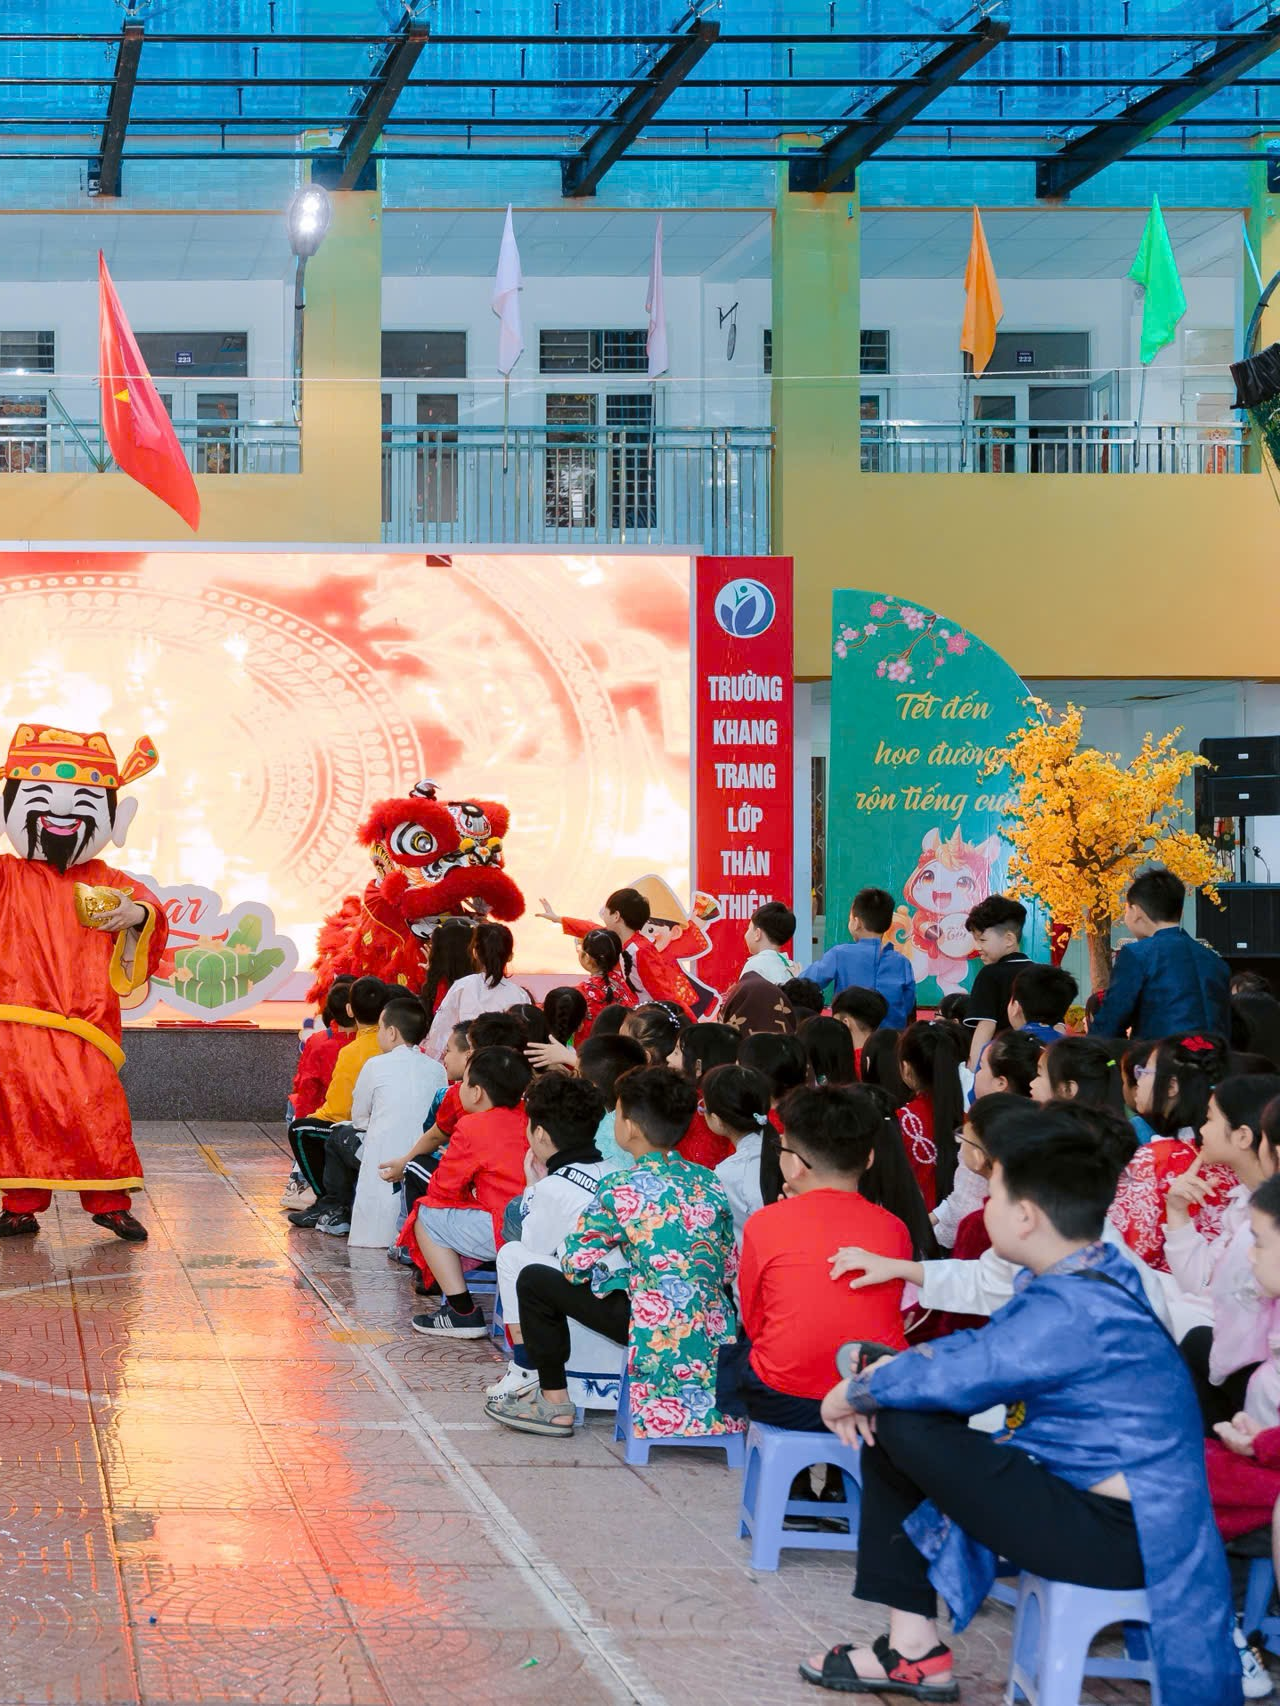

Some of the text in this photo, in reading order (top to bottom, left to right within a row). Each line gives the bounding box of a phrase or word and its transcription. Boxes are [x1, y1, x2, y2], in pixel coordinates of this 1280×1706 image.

[707, 670, 783, 702] TRƯỜNG
[896, 691, 988, 720] Tết đến
[713, 719, 778, 745] KHANG
[874, 741, 920, 769] học
[714, 763, 776, 789] TRANG
[856, 785, 896, 814] rộn
[901, 782, 968, 820] tiếng
[728, 801, 763, 833] LỚP
[720, 845, 770, 876] THÂN
